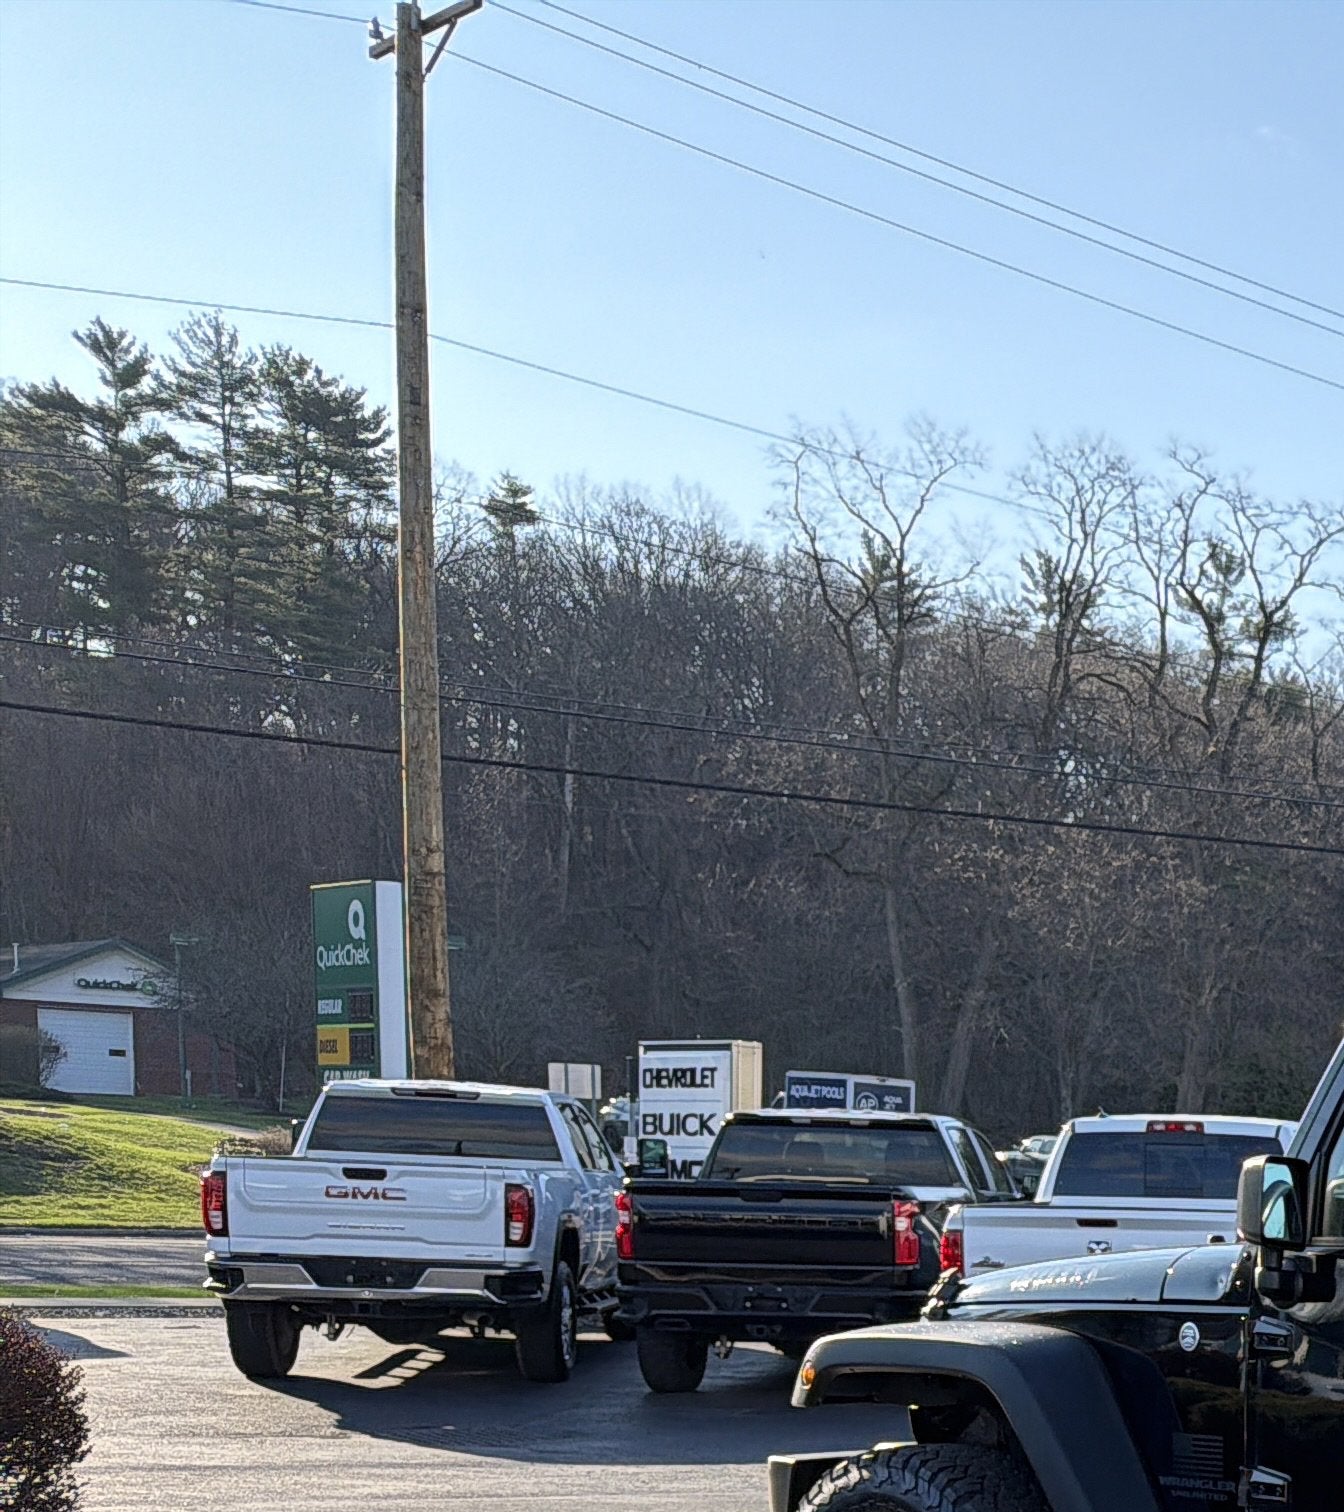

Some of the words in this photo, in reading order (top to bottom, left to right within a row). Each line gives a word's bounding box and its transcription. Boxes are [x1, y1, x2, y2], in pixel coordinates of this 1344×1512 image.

[316, 942, 371, 971] QuickChek
[319, 1039, 338, 1054] DIESEL
[642, 1066, 718, 1089] CHEVROLET
[642, 1112, 718, 1137] BUICK
[669, 1159, 705, 1180] MC
[325, 1185, 407, 1201] GMC
[1159, 1476, 1237, 1494] WRANGLER
